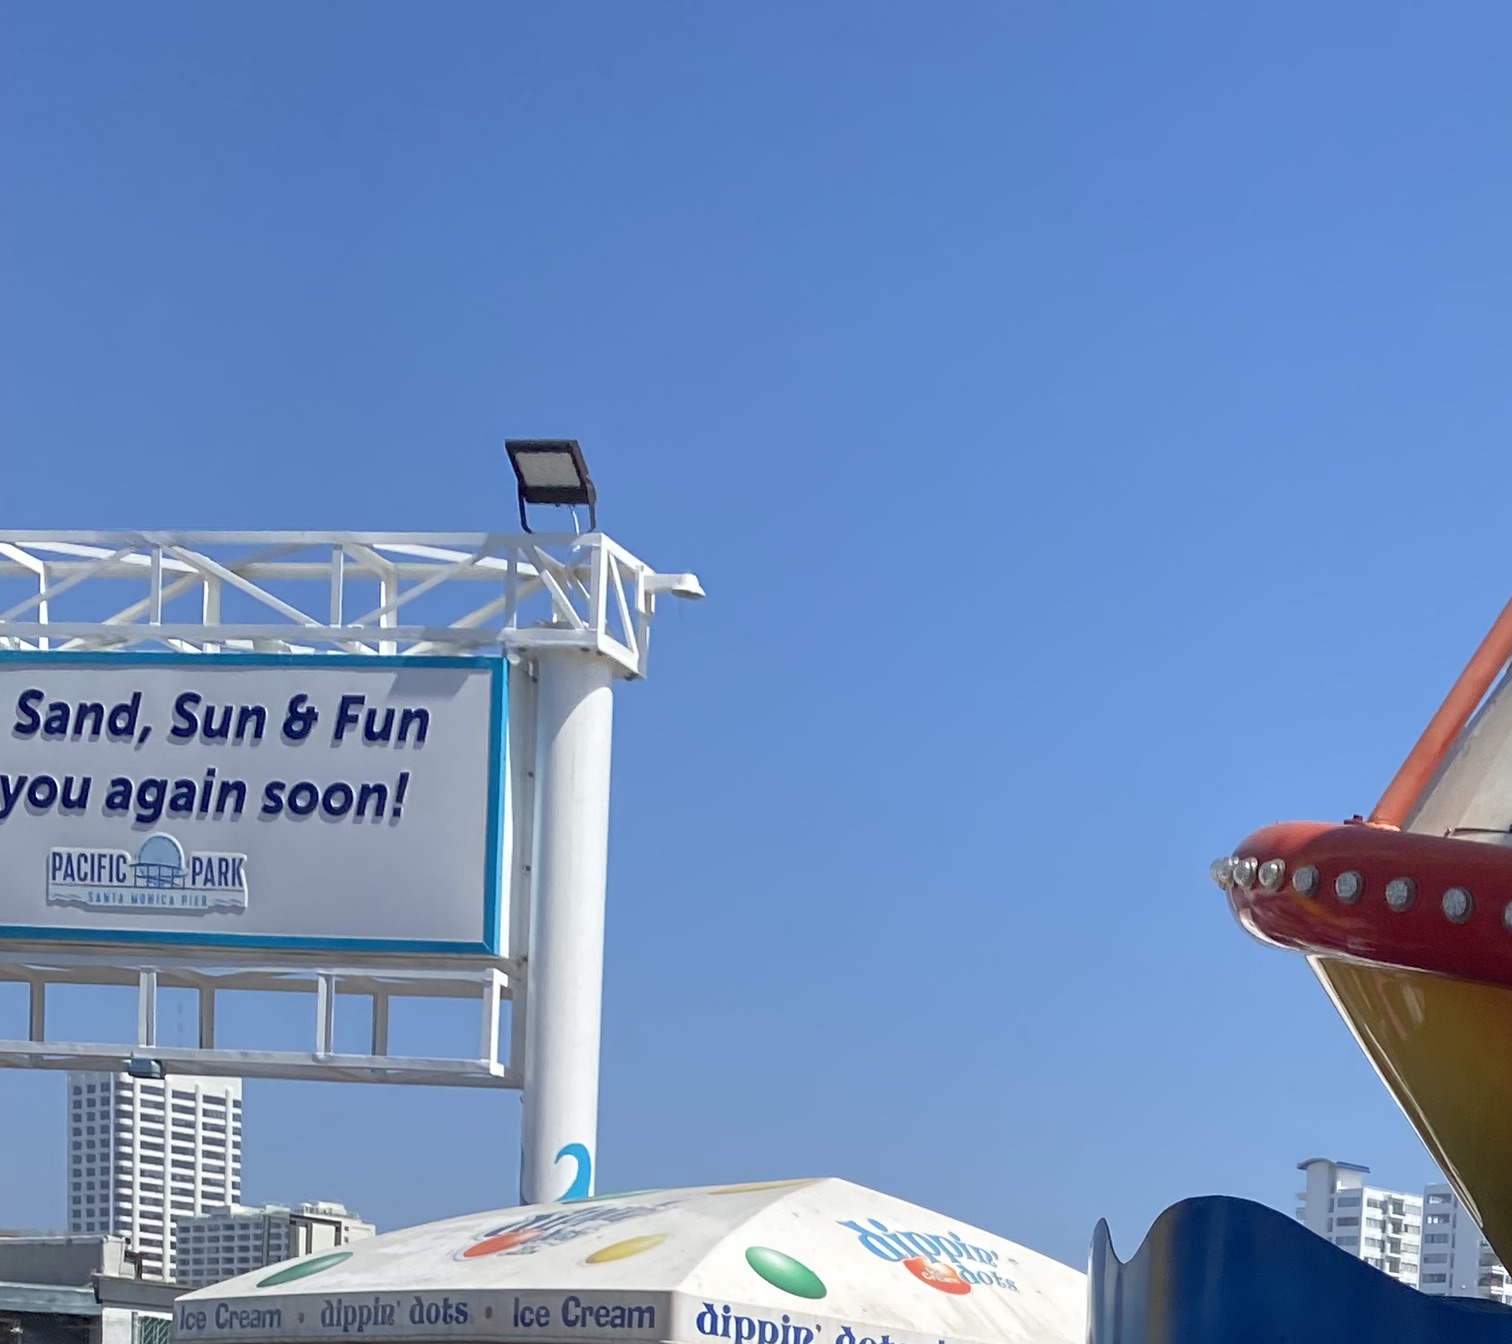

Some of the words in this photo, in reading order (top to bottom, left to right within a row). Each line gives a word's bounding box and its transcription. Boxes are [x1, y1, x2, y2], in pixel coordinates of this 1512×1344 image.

[14, 689, 152, 744] Sand,
[171, 692, 267, 739] Sun
[283, 694, 319, 739] &
[334, 695, 430, 742] Fun
[0, 774, 92, 820] you
[105, 767, 247, 823] again
[261, 771, 410, 818] soon!
[51, 852, 127, 883] PACIFIC
[191, 856, 245, 887] PARK
[87, 890, 125, 904] SANTA
[131, 893, 175, 906] MONICA
[181, 895, 208, 907] PIER
[955, 1263, 1020, 1293] dots
[179, 1304, 207, 1331] Ice
[214, 1302, 282, 1330] Cream
[408, 1295, 469, 1326] dots
[512, 1297, 550, 1328] Ice
[560, 1295, 656, 1329] Cream
